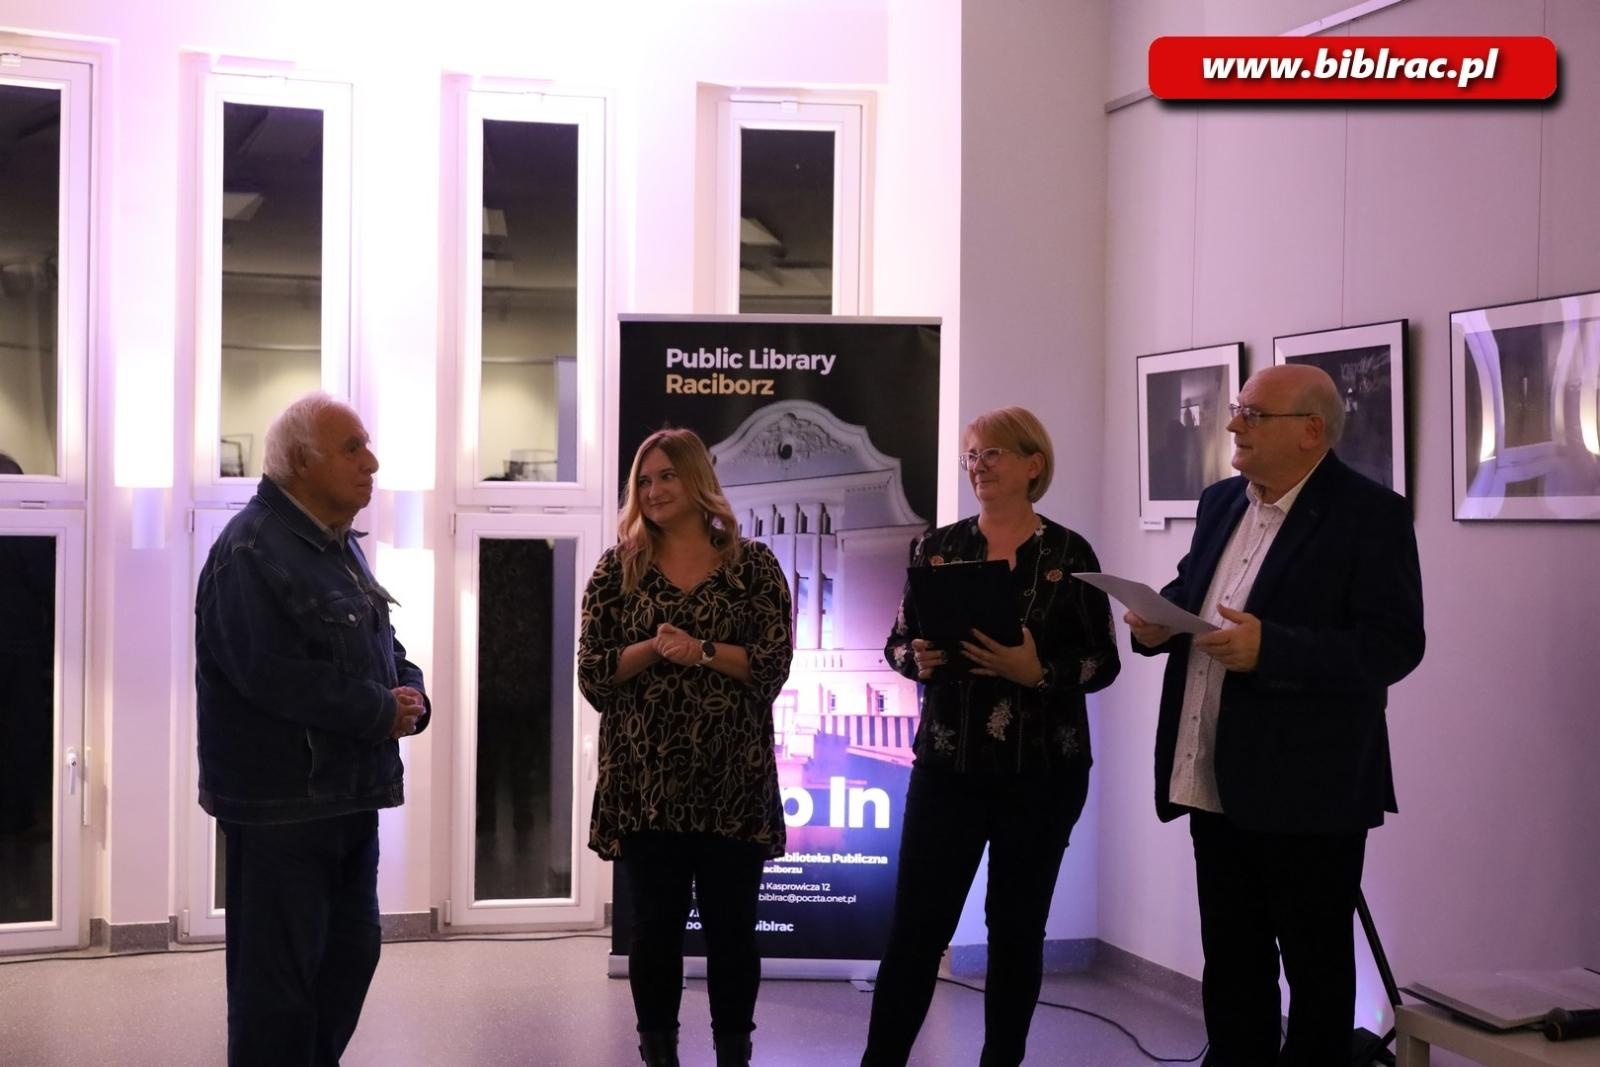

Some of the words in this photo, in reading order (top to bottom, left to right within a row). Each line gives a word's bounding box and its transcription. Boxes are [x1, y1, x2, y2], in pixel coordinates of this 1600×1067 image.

[666, 347, 743, 370] Public
[750, 348, 837, 376] Library
[666, 373, 775, 395] Raciborz
[829, 776, 890, 829] In
[832, 853, 888, 865] Publiczna
[763, 866, 803, 875] aciborzu
[766, 882, 820, 893] Kasprowicza
[822, 883, 831, 892] 12
